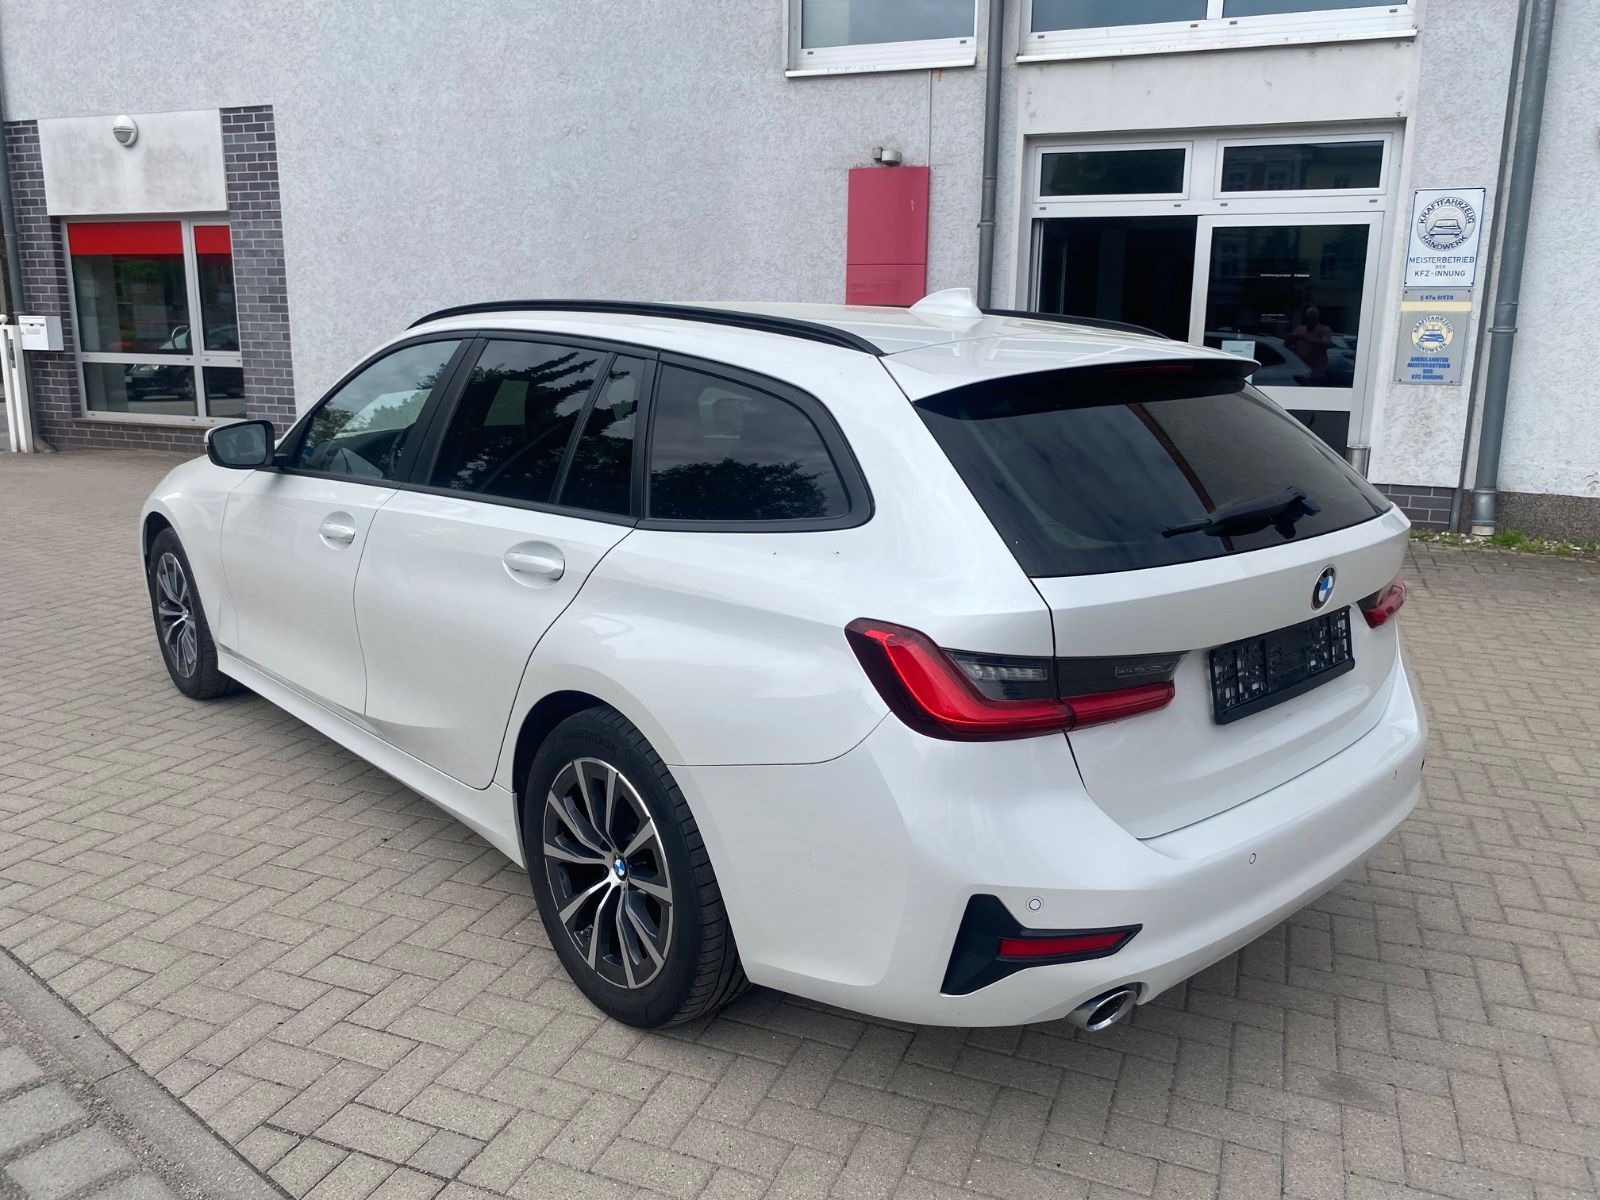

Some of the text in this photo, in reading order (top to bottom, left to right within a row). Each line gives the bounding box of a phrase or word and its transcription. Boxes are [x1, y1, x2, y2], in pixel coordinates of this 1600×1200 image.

[1419, 198, 1475, 224] KRAFTFAHRZEUG
[1421, 234, 1468, 250] HANDWERK
[1409, 256, 1475, 264] MEISTERBETRIEB
